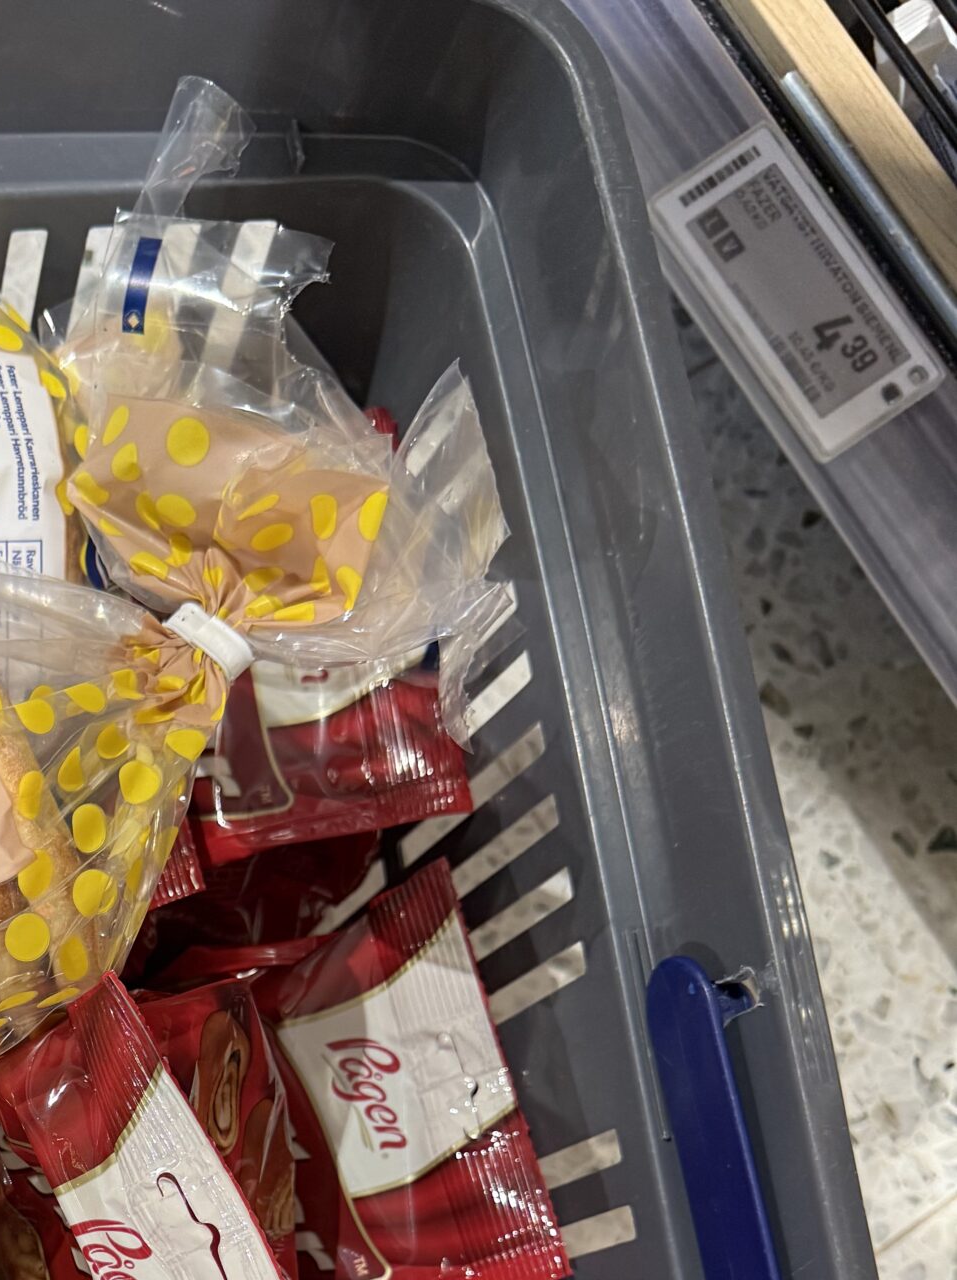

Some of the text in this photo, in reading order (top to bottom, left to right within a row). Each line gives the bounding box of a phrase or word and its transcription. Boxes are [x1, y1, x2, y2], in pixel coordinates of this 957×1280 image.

[746, 177, 783, 223] FAZER
[0, 391, 18, 436] Lemppari
[11, 438, 27, 520] Havretunnbröd
[6, 365, 40, 521] Fazer Lemppari Kaurarieskanen
[326, 1038, 407, 1149] Pågen
